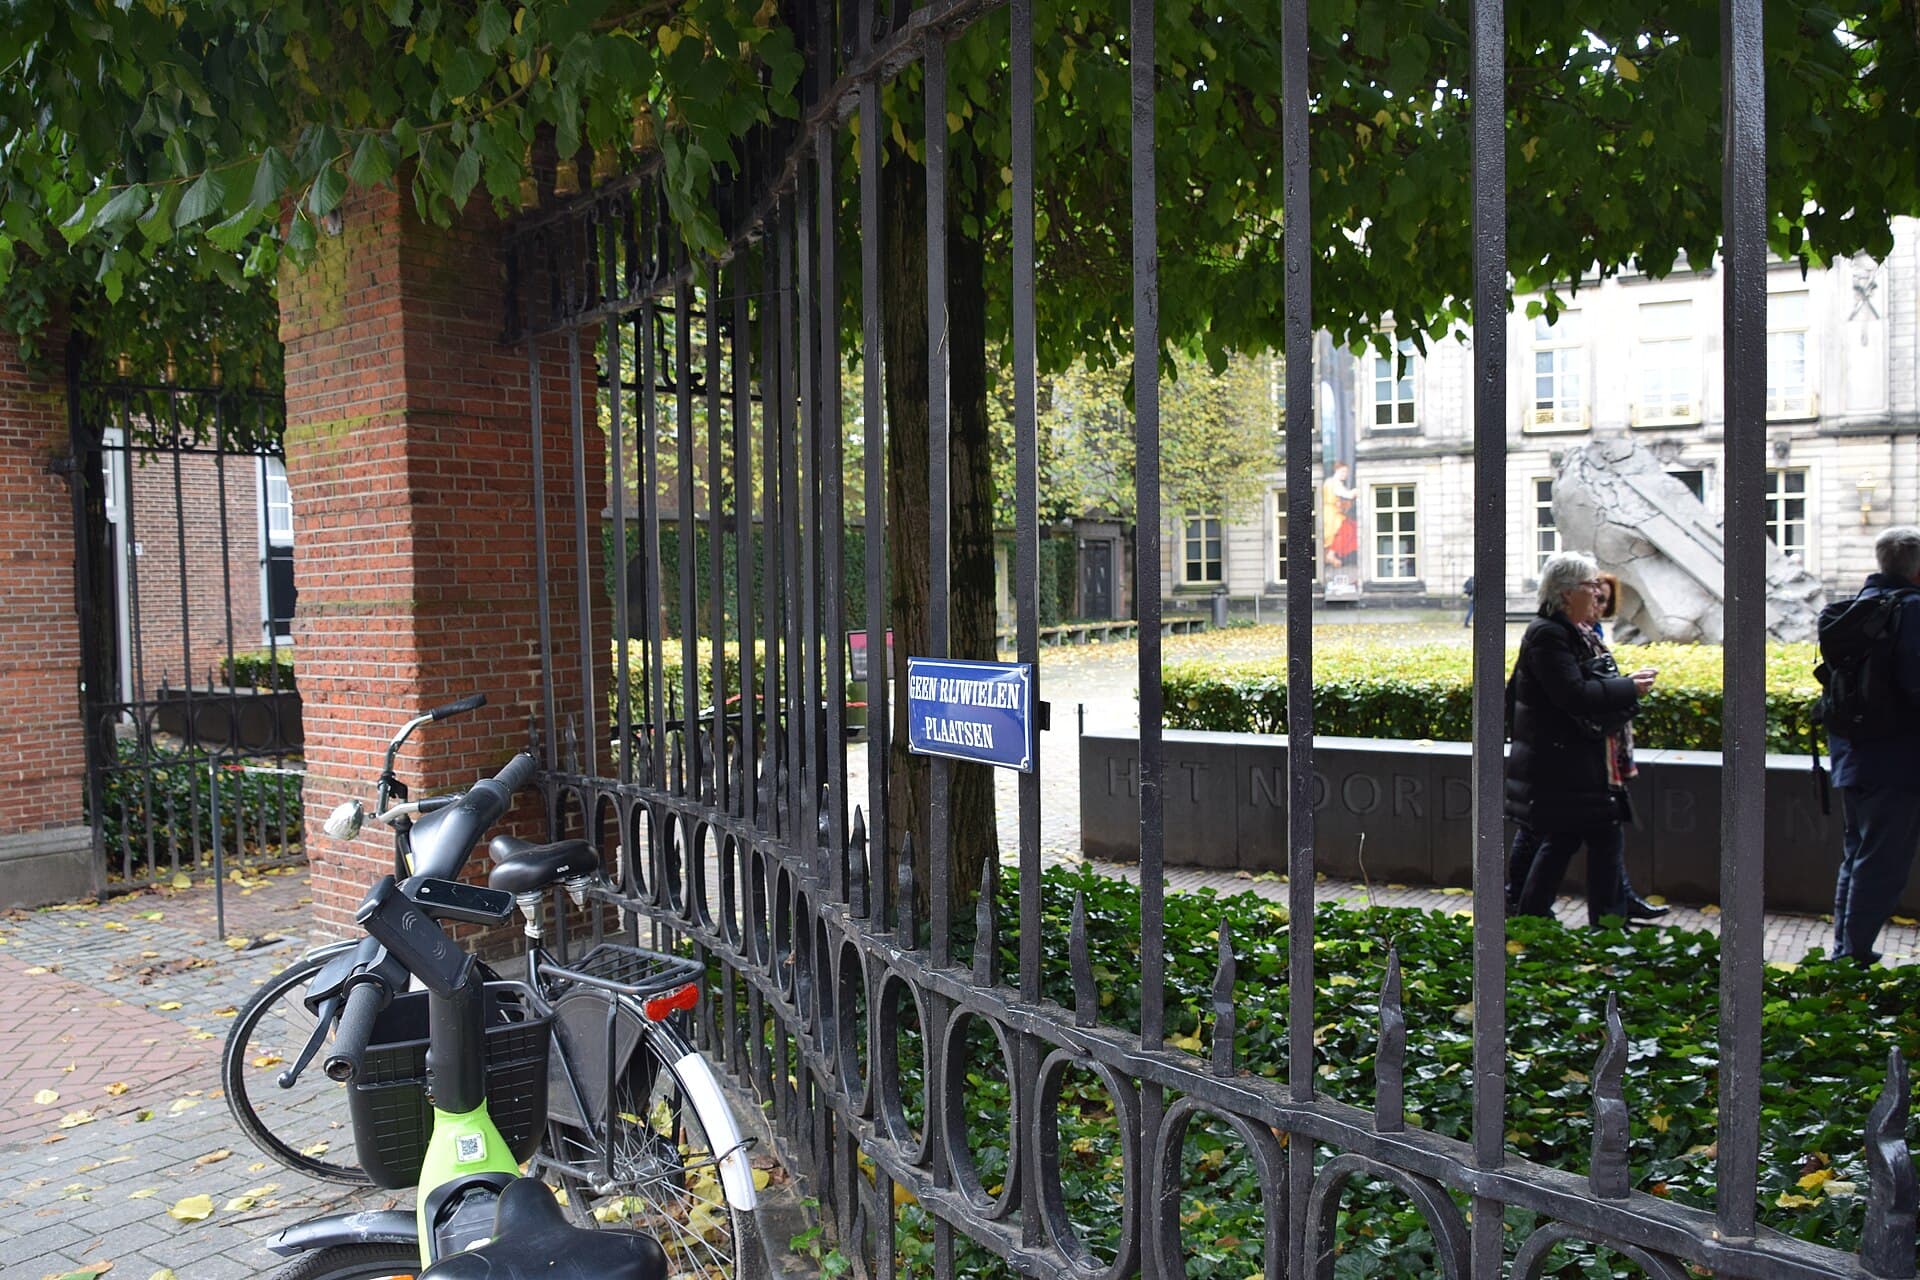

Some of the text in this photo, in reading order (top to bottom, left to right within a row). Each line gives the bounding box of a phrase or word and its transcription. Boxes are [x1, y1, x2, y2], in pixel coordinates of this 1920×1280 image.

[910, 675, 1021, 710] GEEN RIJWIELEN
[924, 716, 994, 749] PLAATSEN
